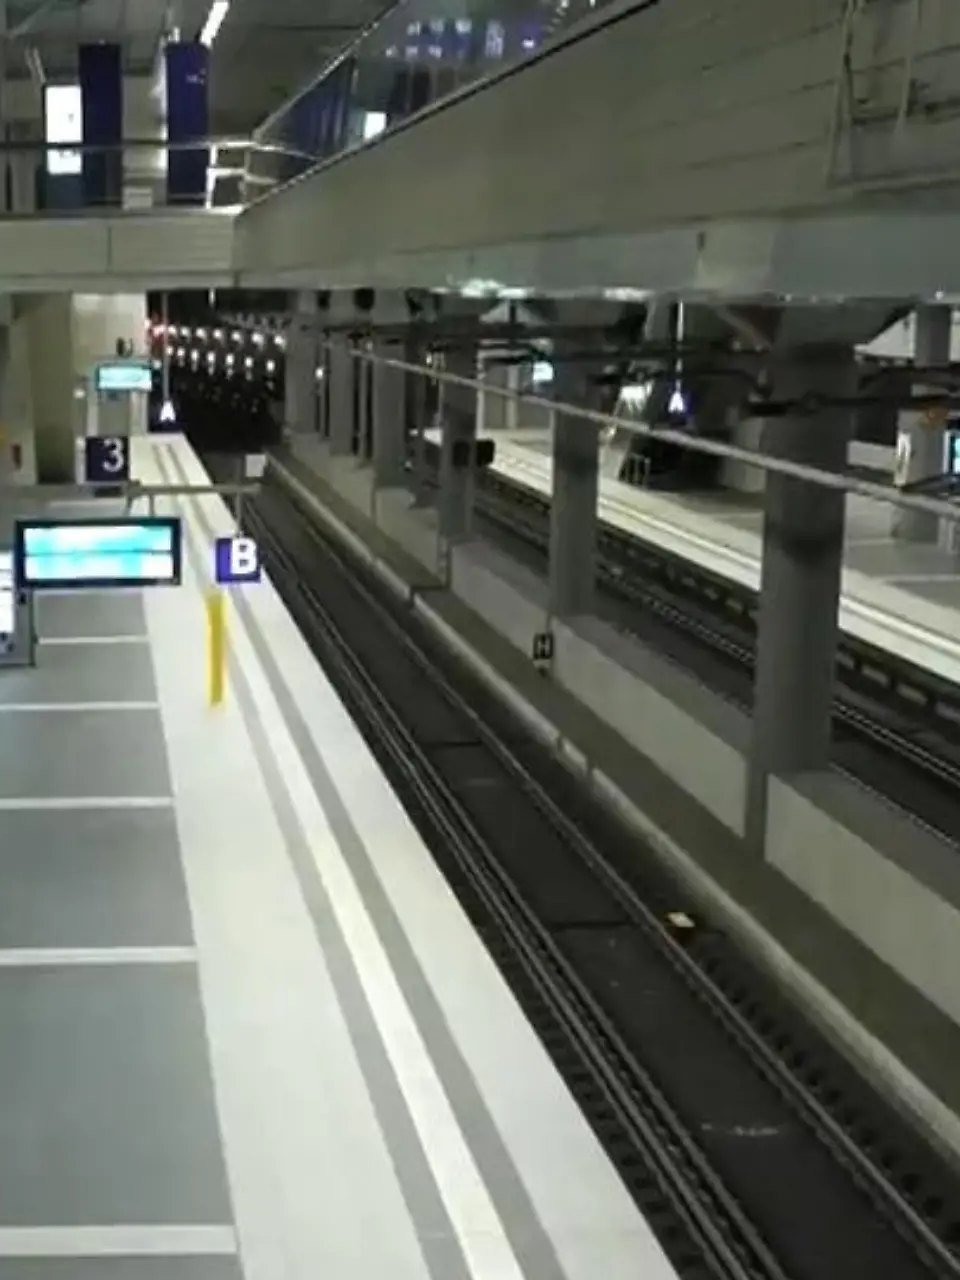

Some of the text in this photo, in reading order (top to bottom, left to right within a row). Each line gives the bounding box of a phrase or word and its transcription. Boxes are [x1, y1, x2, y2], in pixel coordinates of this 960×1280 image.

[160, 401, 177, 422] A
[102, 438, 124, 472] 3
[231, 538, 258, 574] B
